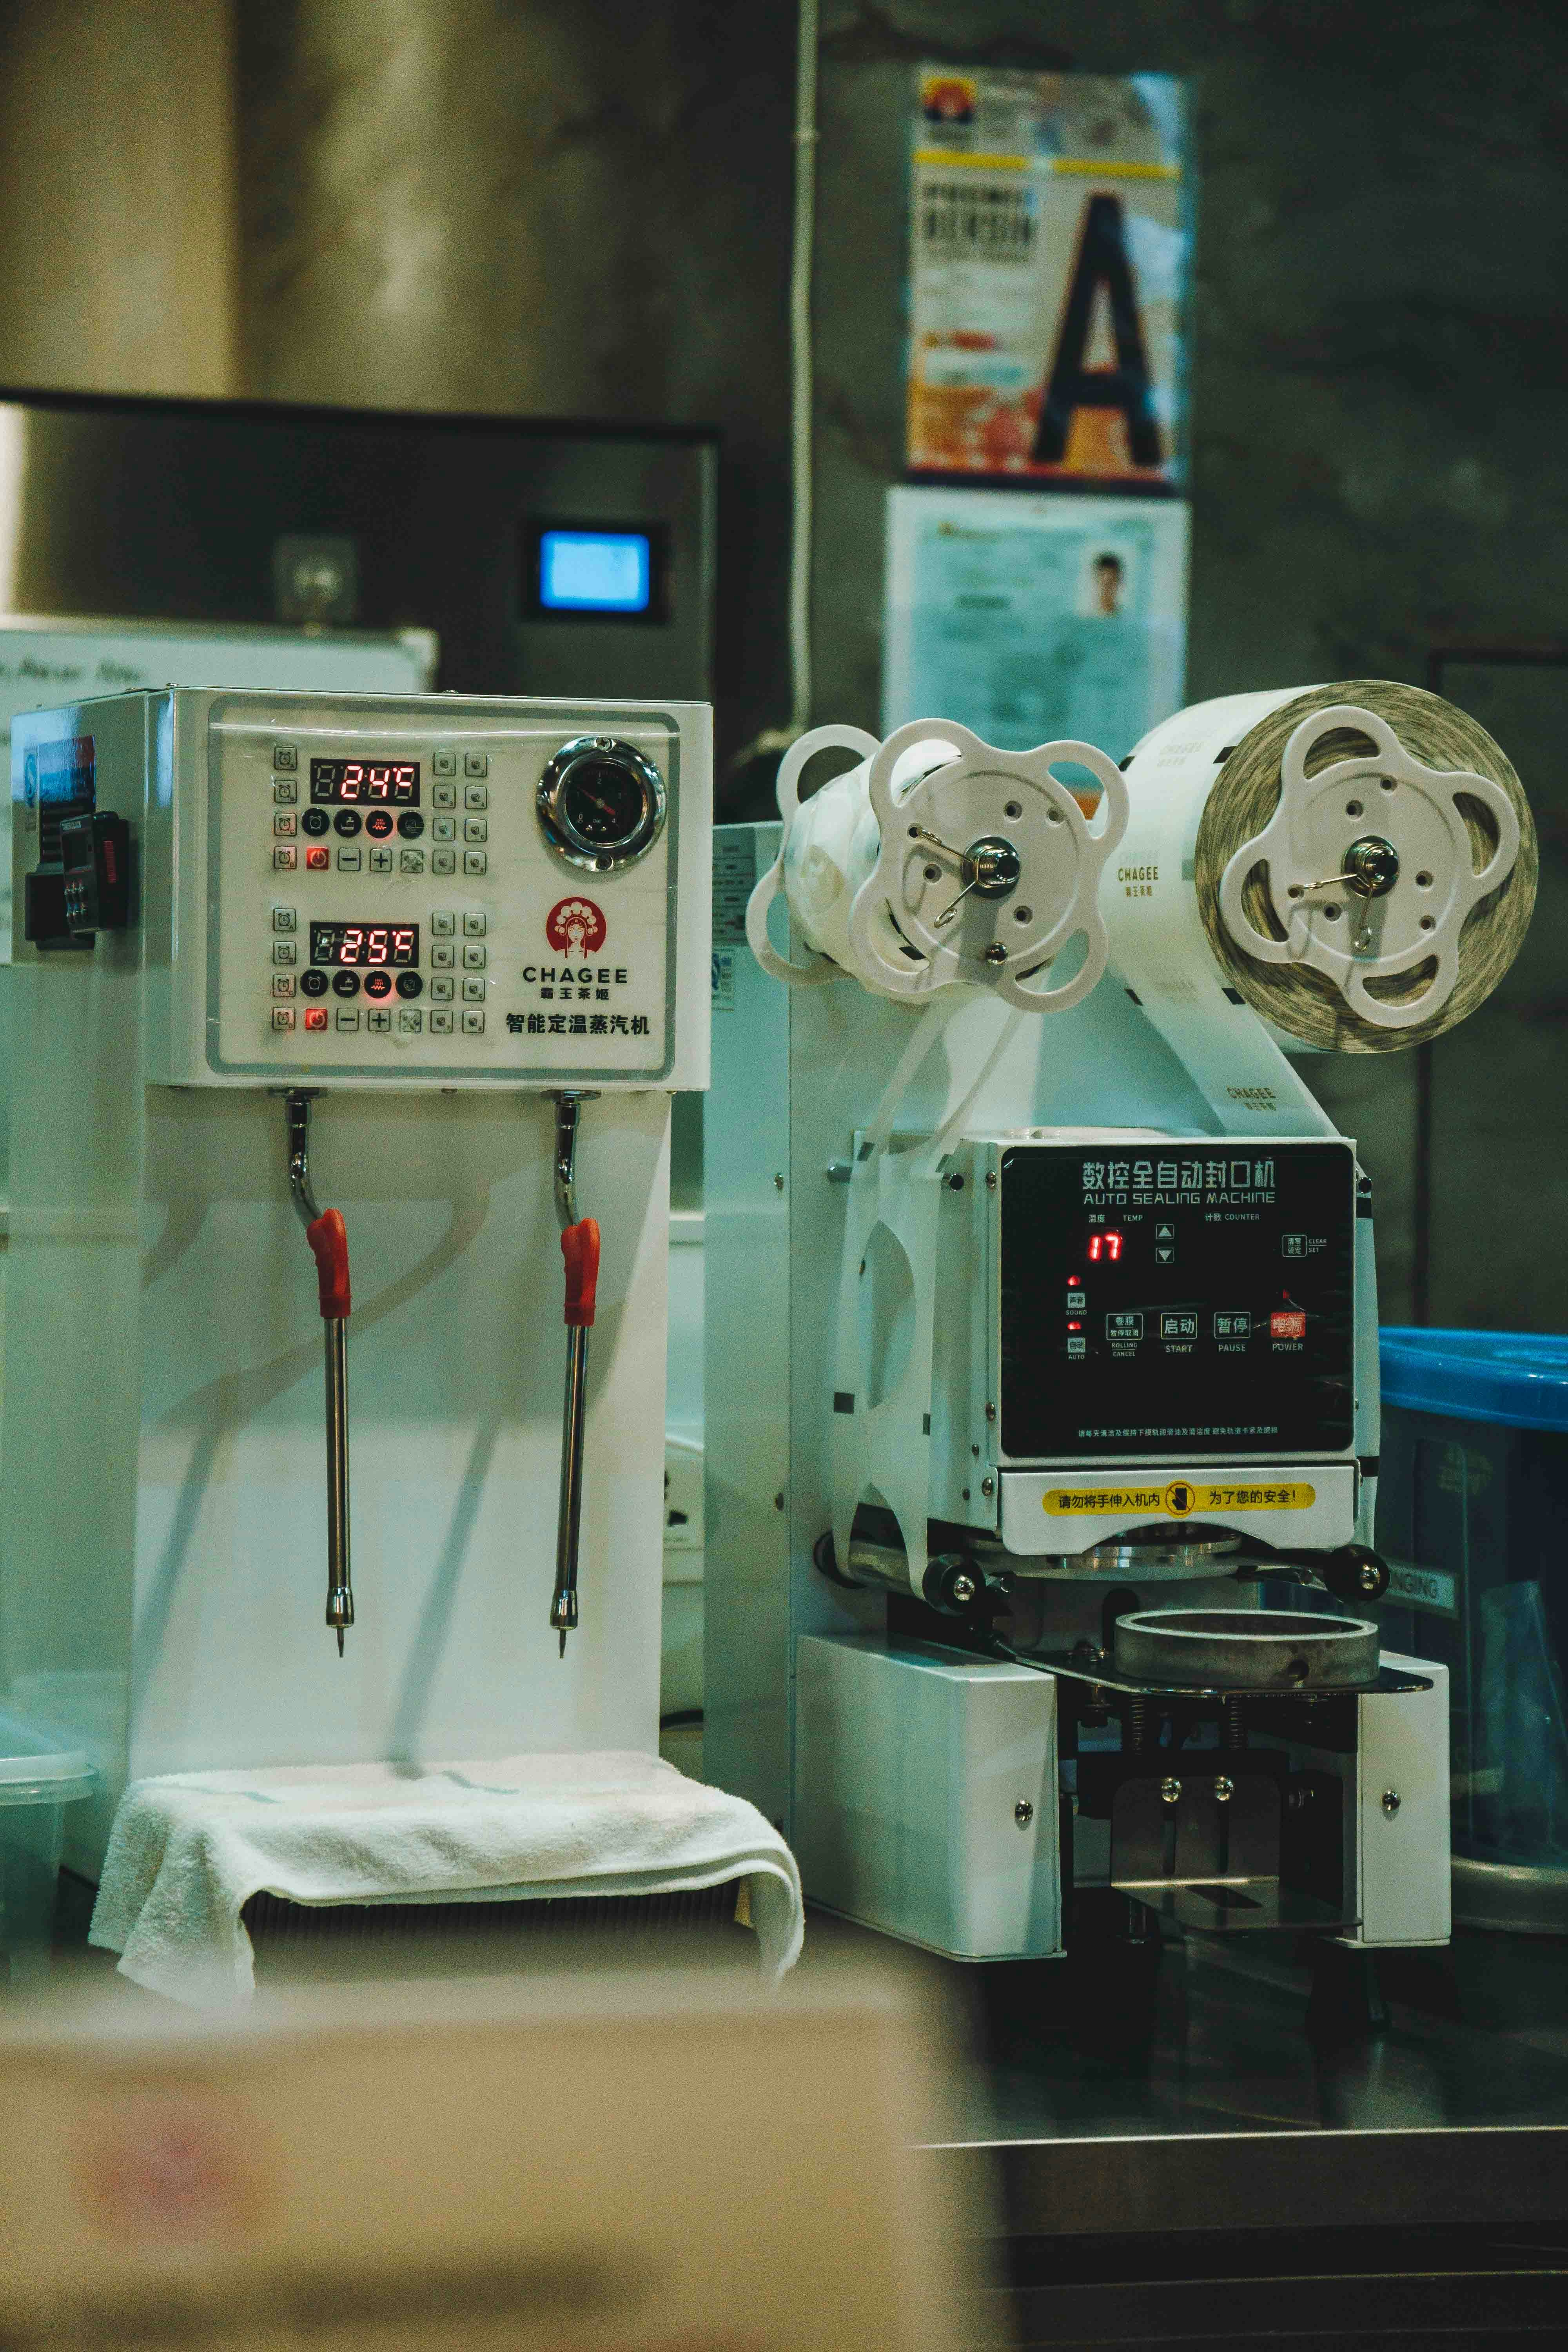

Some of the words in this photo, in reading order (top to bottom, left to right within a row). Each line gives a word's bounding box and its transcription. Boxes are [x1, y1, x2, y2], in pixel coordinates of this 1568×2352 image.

[1032, 191, 1162, 467] A
[1118, 866, 1159, 882] CHAGEE
[522, 966, 628, 984] CHAGEE
[540, 987, 610, 1000] 霸王茶姬
[506, 1013, 650, 1035] 智能定温蒸汽机
[1227, 1088, 1276, 1098] CHAGEE
[1082, 1160, 1276, 1190] 数控全自动封口机
[1083, 1192, 1127, 1205] AUTO
[1132, 1192, 1201, 1205] SEALING
[1206, 1192, 1276, 1204] MACHINE
[1088, 1214, 1105, 1223] 温度
[1205, 1211, 1221, 1221] 计数
[1090, 1234, 1121, 1260] 17
[1116, 1316, 1134, 1326] 卷膜
[1164, 1318, 1195, 1334] 启动
[1217, 1317, 1248, 1334] 暂停
[1165, 1345, 1193, 1353] START
[1218, 1344, 1246, 1352] PAUSE
[1272, 1343, 1303, 1352] POWER
[1058, 1495, 1161, 1509] 请勿将手伸入机内
